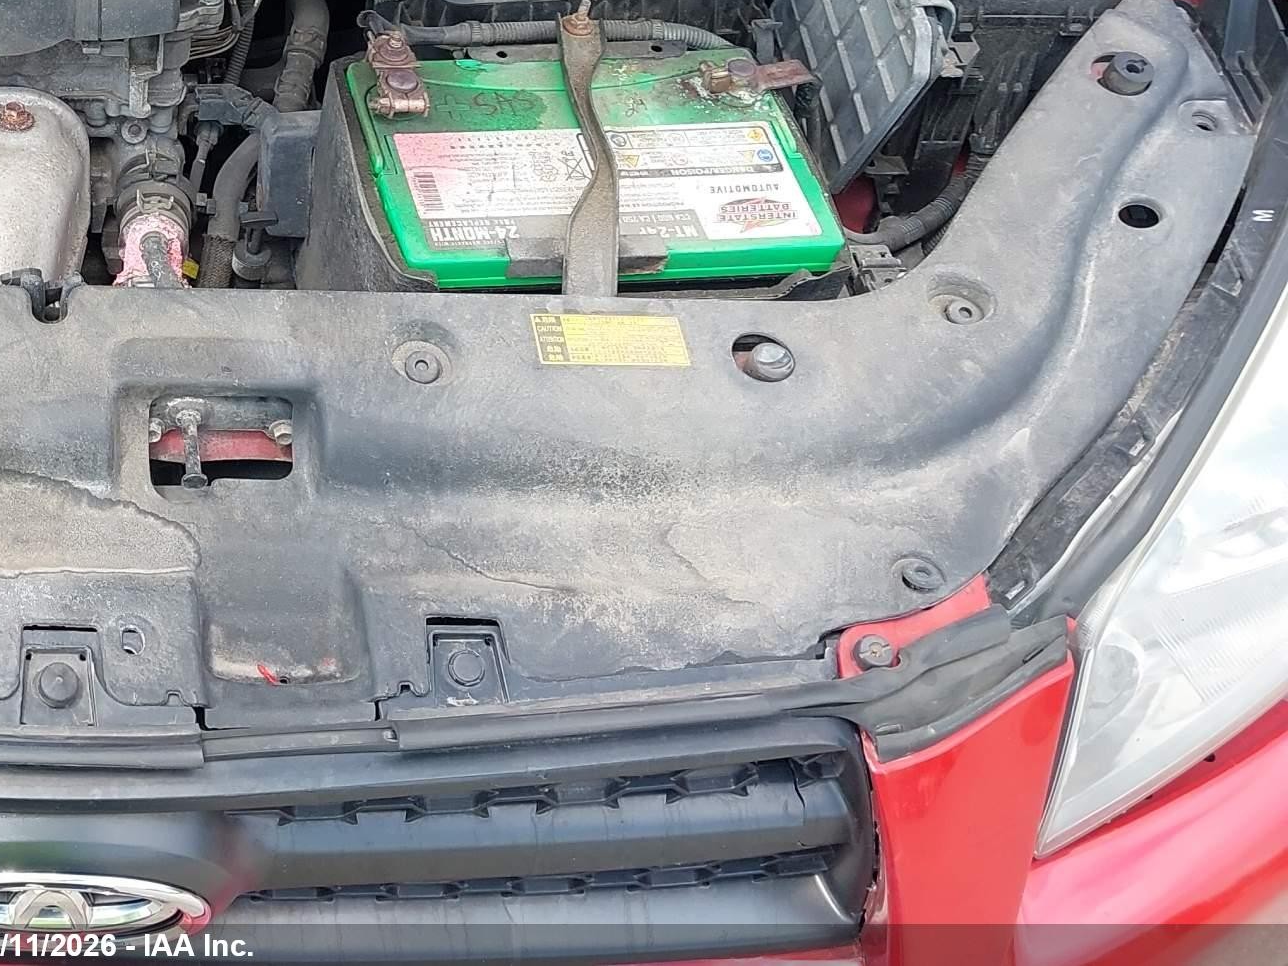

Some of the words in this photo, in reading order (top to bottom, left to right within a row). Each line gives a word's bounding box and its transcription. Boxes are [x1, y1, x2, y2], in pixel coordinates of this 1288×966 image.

[710, 183, 779, 194] AUTOMOTIVE
[720, 202, 790, 213] BATTERIES
[718, 211, 797, 222] INTERSTATE
[428, 219, 491, 228] REPLACEMENT
[429, 225, 520, 242] 24-MONTH
